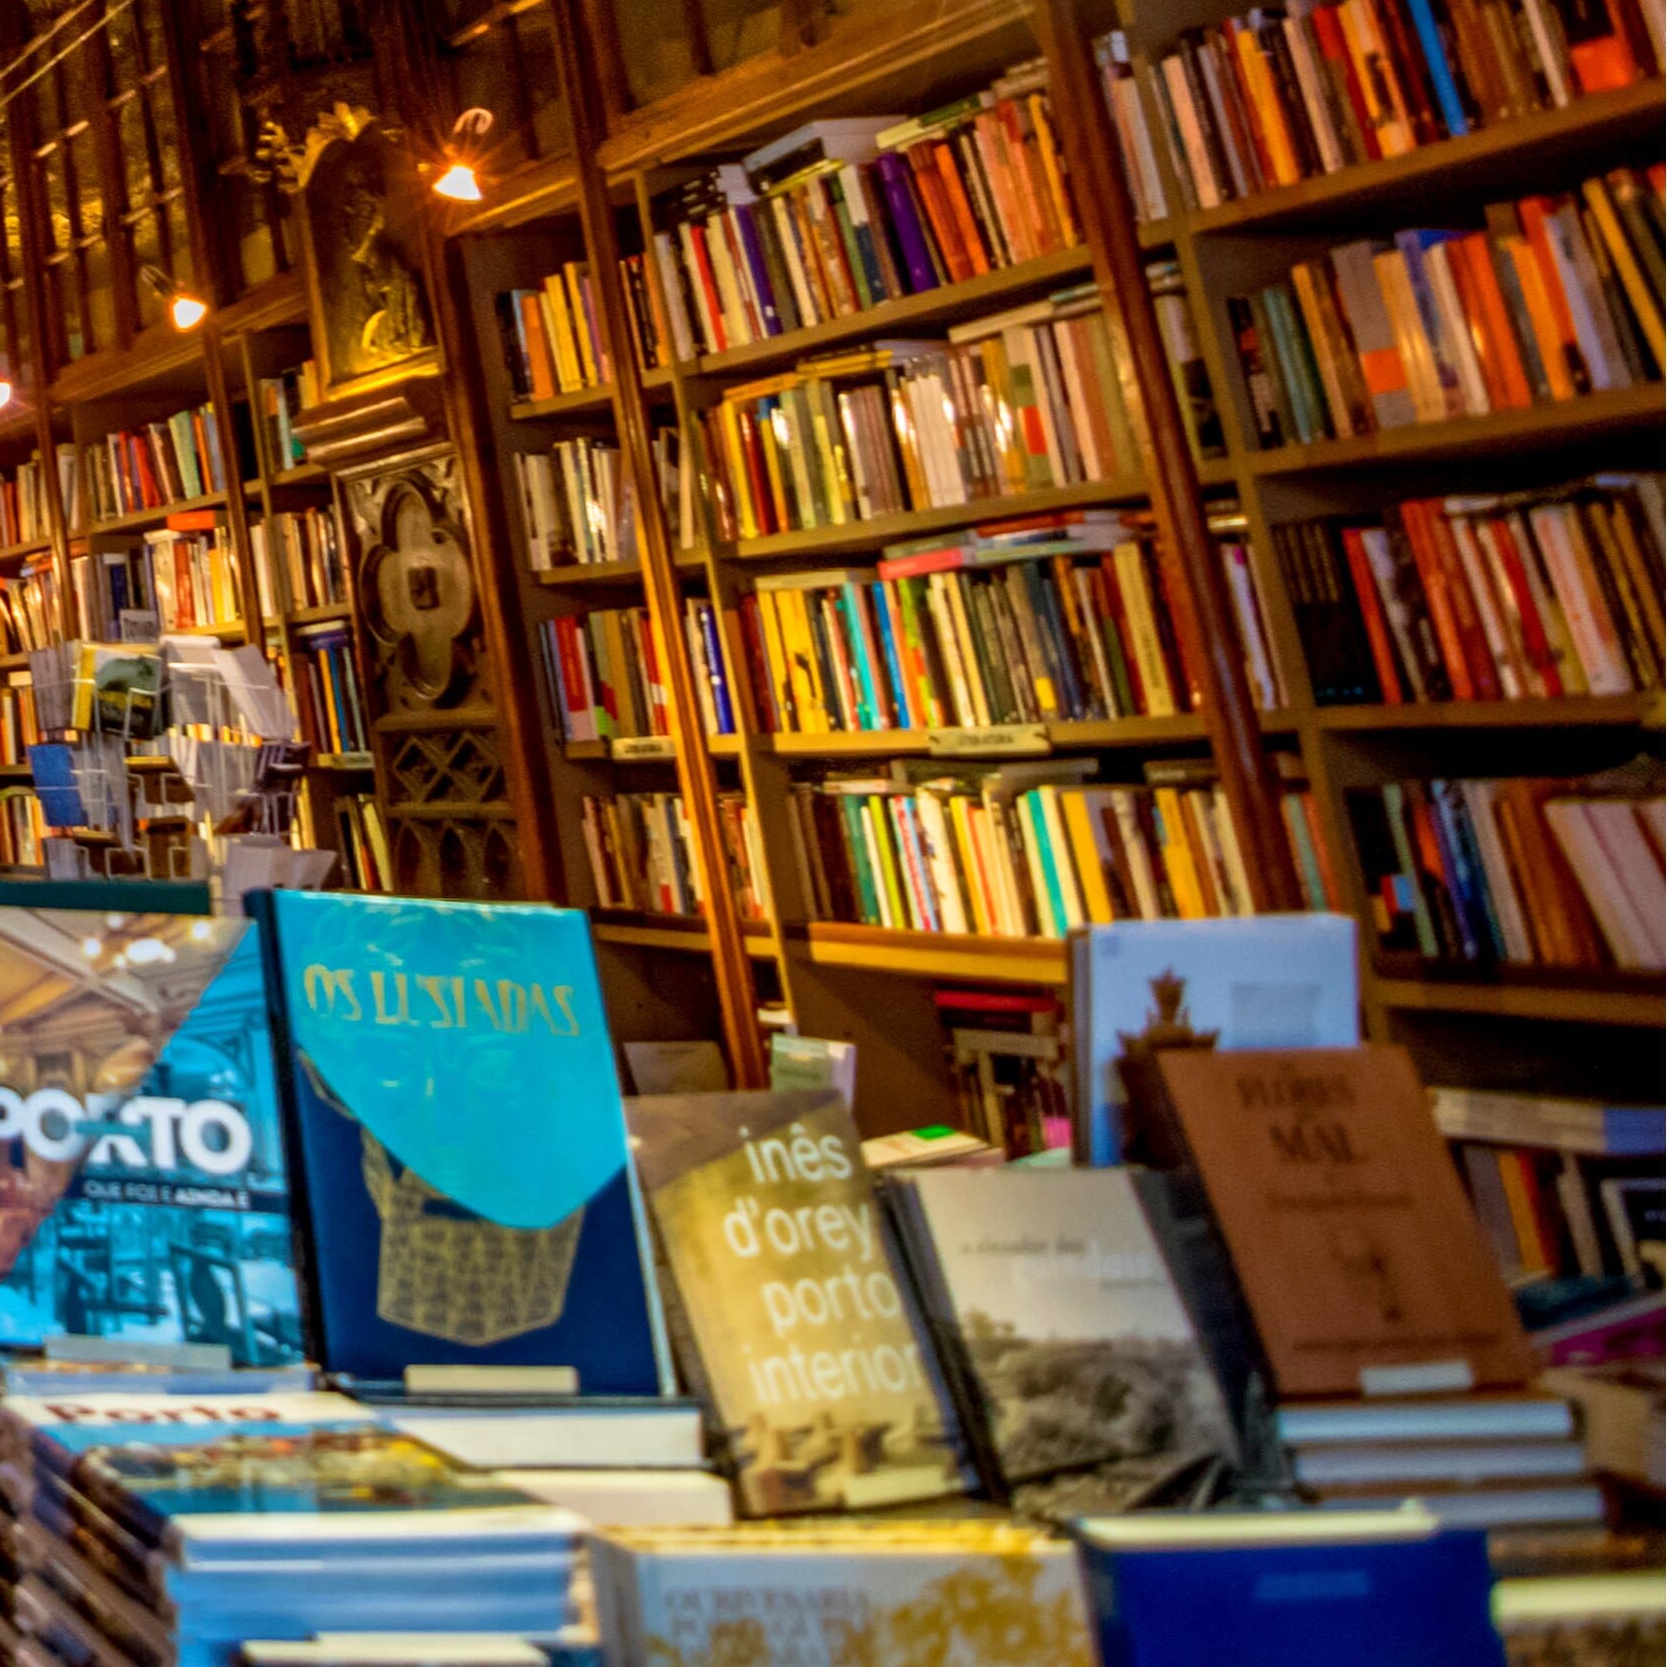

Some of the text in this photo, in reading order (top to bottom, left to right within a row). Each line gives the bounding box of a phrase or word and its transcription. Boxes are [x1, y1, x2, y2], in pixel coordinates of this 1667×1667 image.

[303, 963, 362, 1022] OS
[738, 1121, 853, 1184] inês
[762, 1264, 900, 1339] porto
[740, 1332, 920, 1405] interior
[42, 1402, 281, 1424] Porto
